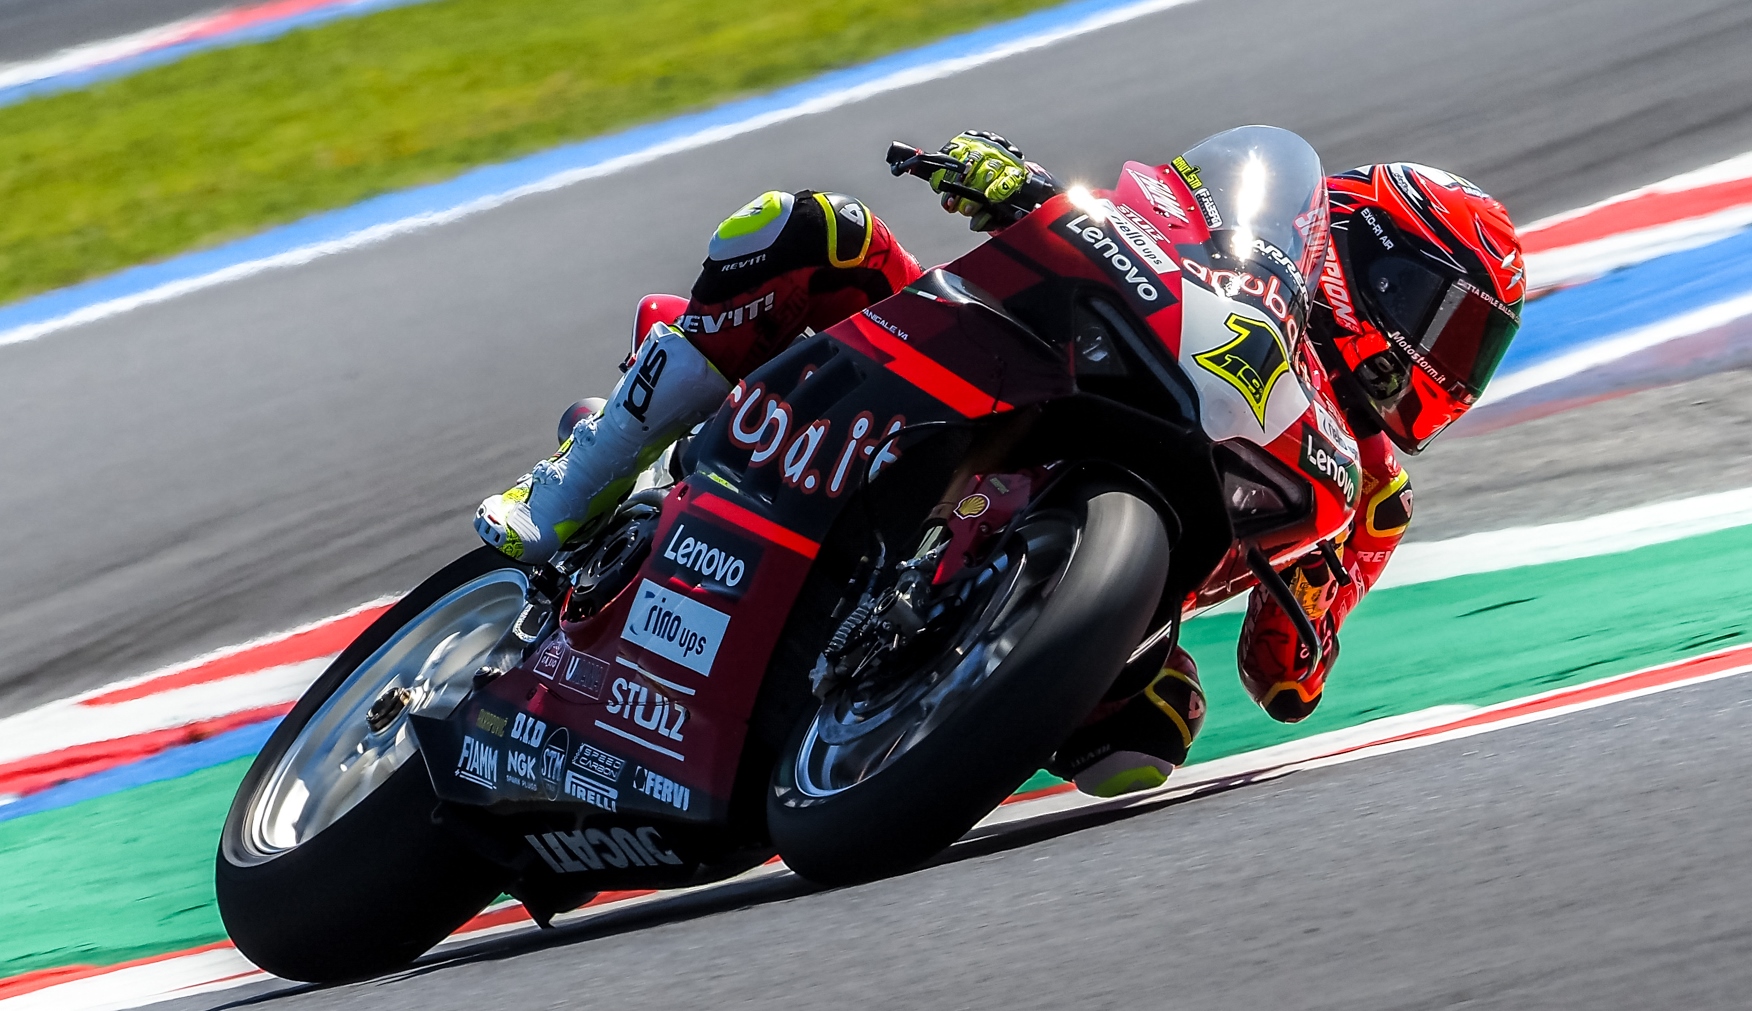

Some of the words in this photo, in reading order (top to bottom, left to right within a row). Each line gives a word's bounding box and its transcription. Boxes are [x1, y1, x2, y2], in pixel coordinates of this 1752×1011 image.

[1360, 207, 1382, 239] EXO-R1
[1380, 235, 1395, 250] AIR
[721, 253, 767, 273] REV'IT!
[1066, 214, 1158, 301] Lenovo
[1143, 246, 1163, 265] ups
[1391, 330, 1447, 385] Motostorm.it
[1308, 434, 1355, 503] Lenovo
[663, 524, 745, 587] Lenovo
[679, 624, 707, 658] ups
[606, 677, 687, 742] STULZ
[457, 735, 499, 783] FIAMM
[507, 749, 537, 781] NGK
[578, 757, 618, 779] CARBON
[583, 748, 623, 768] SPEED
[564, 769, 619, 813] PIRELLI
[644, 771, 690, 812] FERVI
